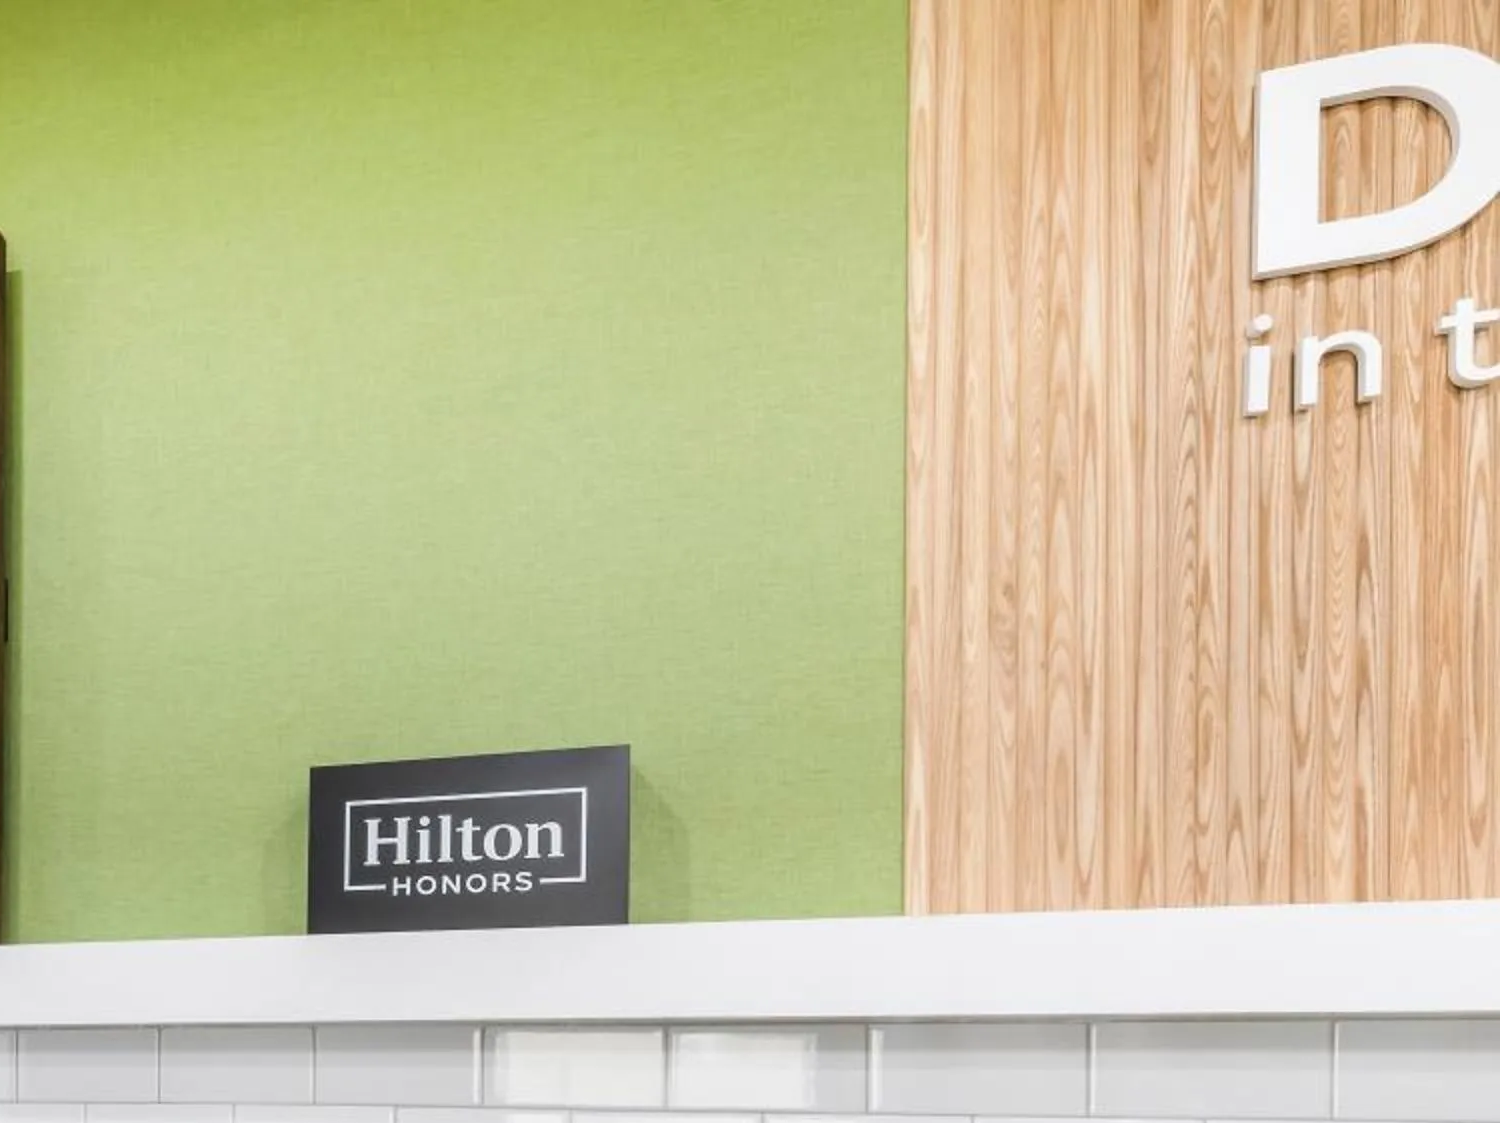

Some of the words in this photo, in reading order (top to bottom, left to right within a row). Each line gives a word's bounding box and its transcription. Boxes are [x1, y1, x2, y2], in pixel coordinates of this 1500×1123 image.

[1244, 314, 1382, 417] in
[363, 815, 565, 866] Hilton
[392, 872, 533, 896] HONORS
